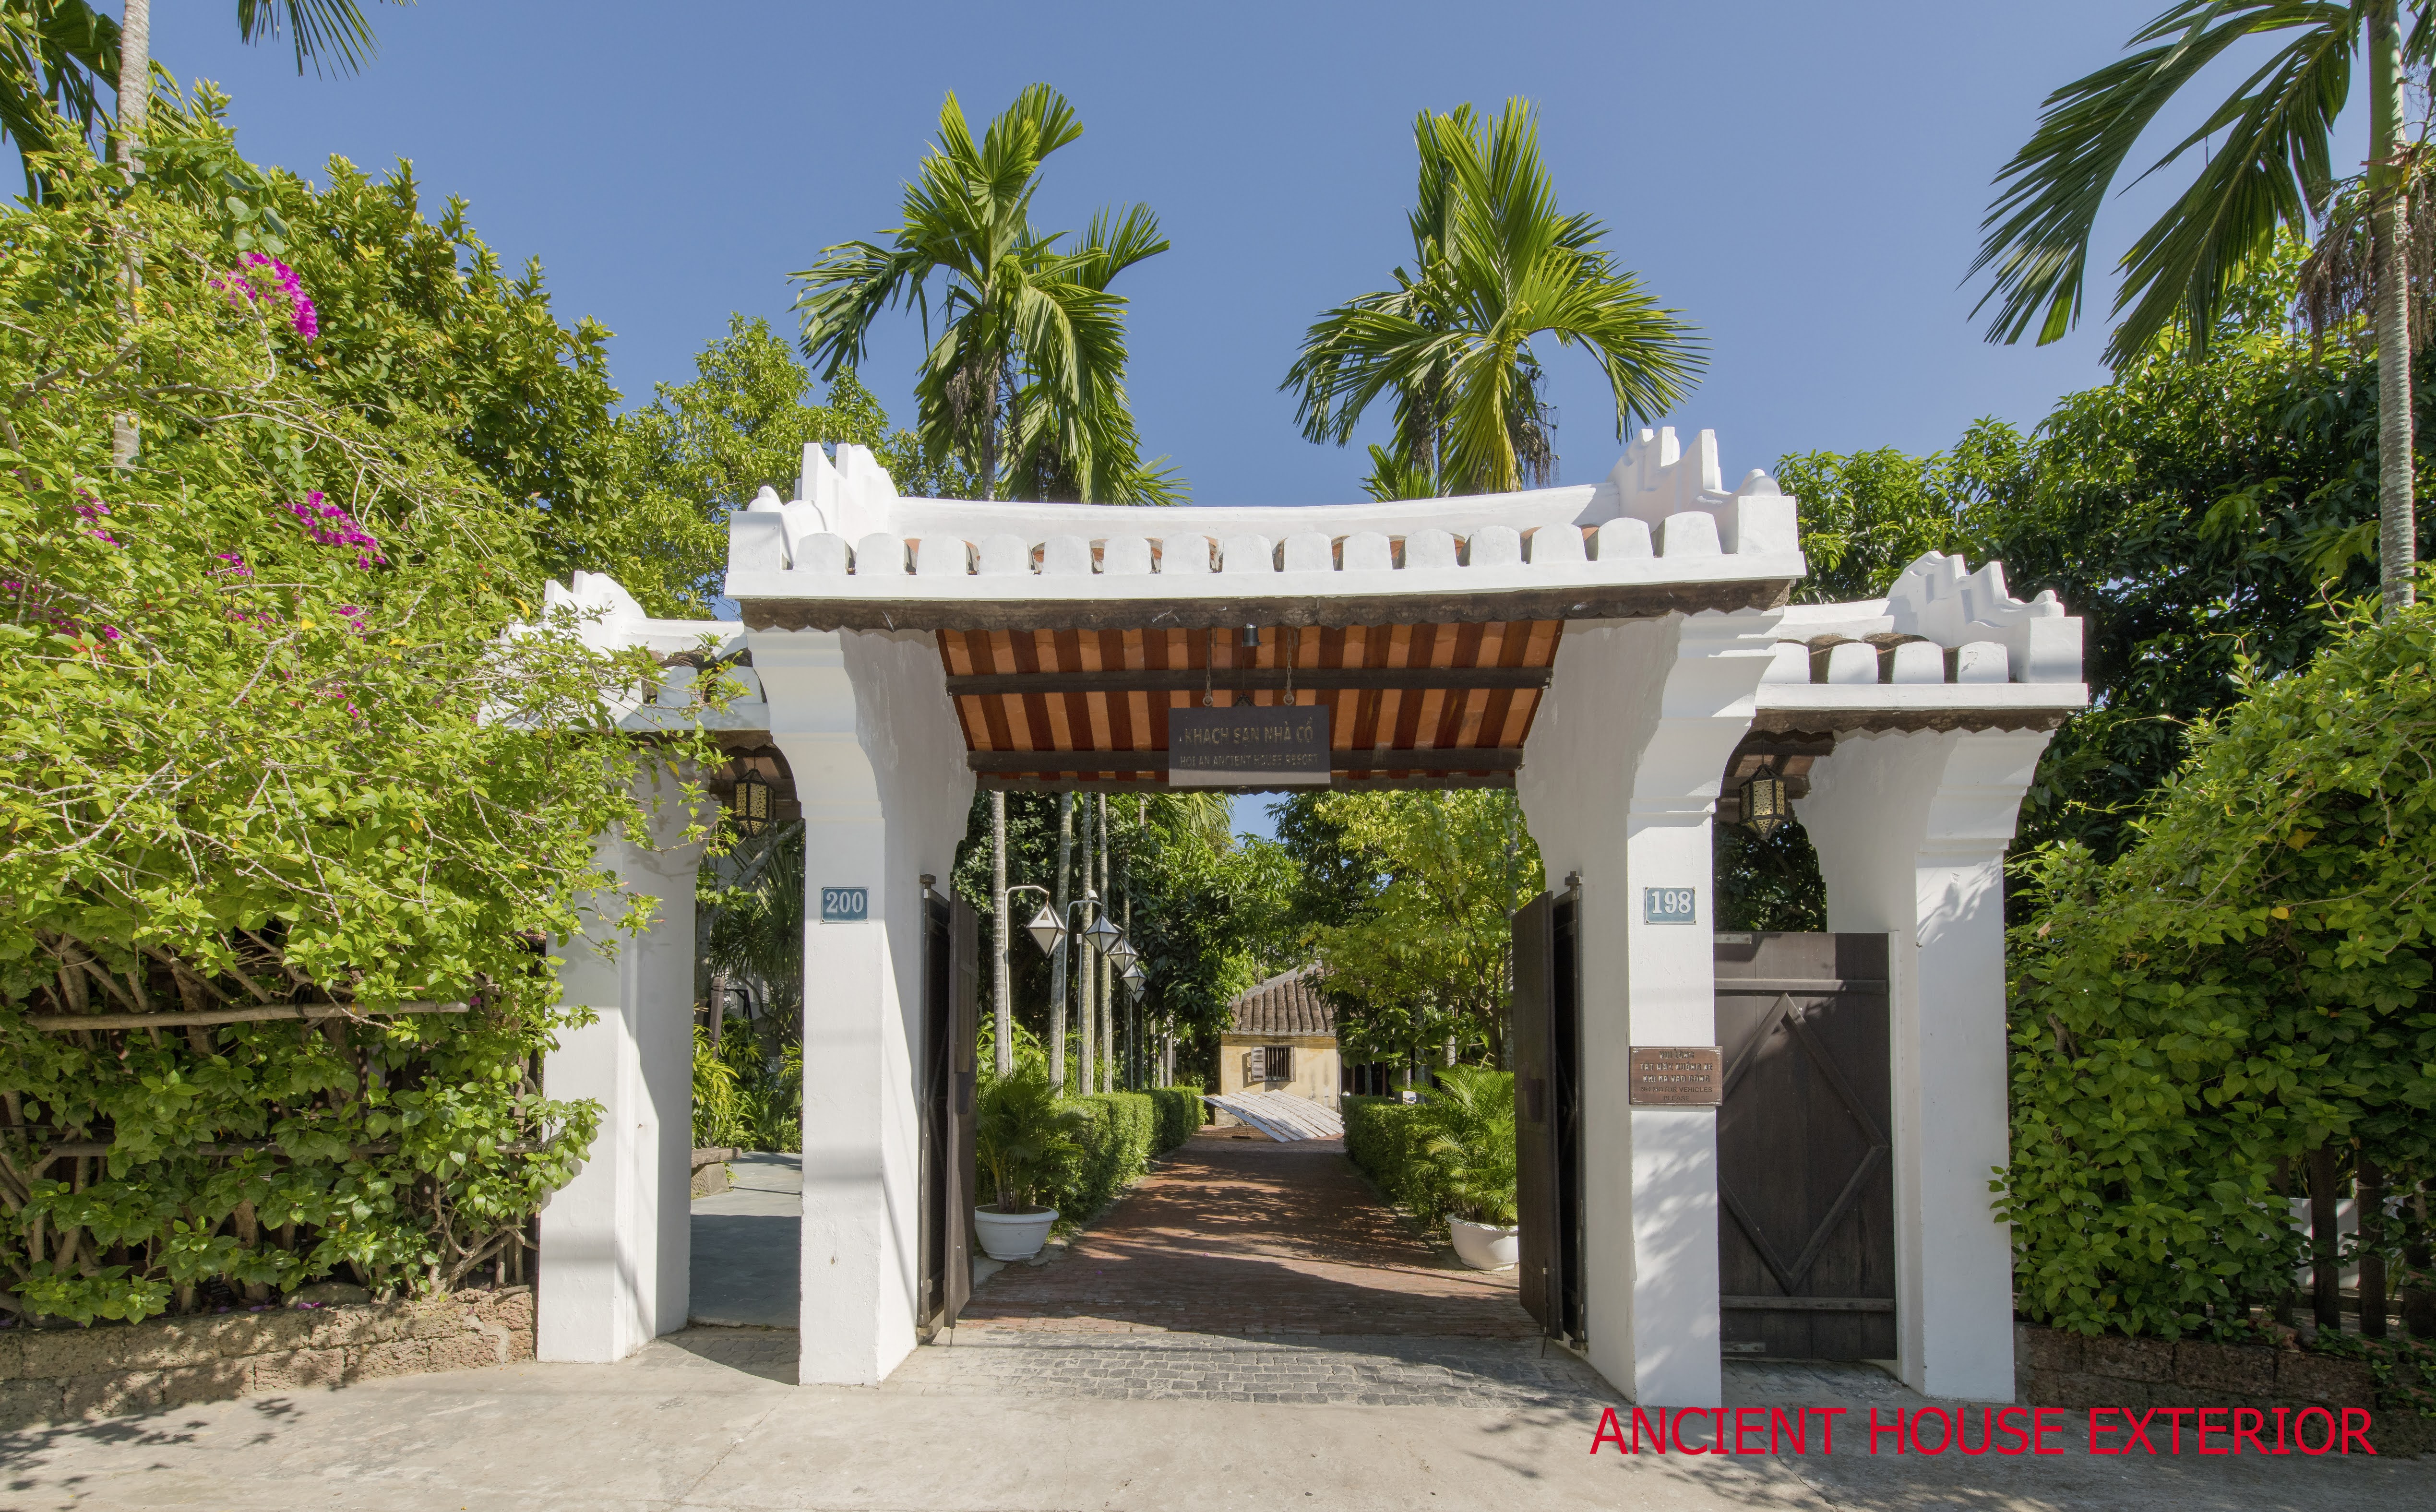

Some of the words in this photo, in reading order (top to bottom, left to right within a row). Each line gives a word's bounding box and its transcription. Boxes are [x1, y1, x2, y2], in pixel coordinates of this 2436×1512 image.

[1264, 721, 1292, 743] NHÀ
[1199, 755, 1210, 766] AN
[1213, 754, 1251, 767] ANCIENT
[1254, 754, 1282, 765] HOUSE
[1286, 753, 1318, 765] RESORT
[826, 892, 864, 913] 200
[1651, 891, 1691, 914] 198
[1643, 1074, 1656, 1083] KHI
[1659, 1074, 1669, 1083] RA
